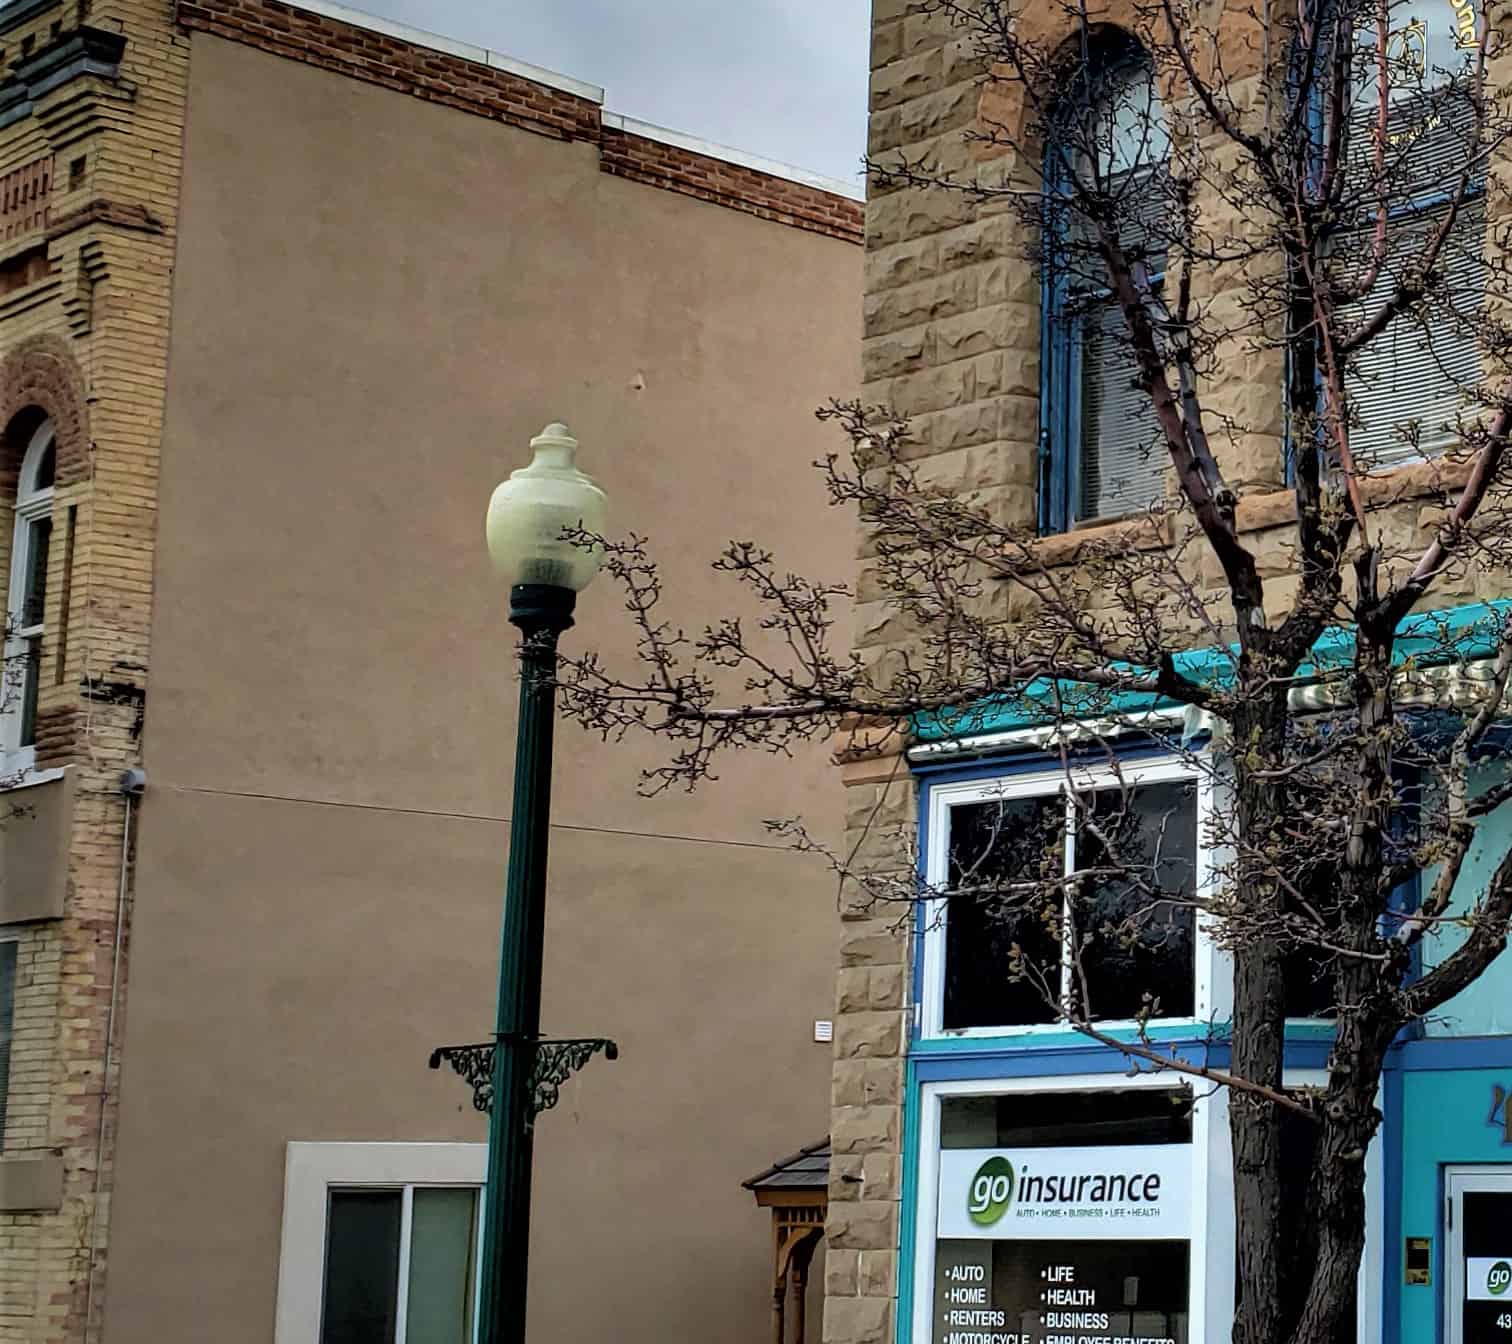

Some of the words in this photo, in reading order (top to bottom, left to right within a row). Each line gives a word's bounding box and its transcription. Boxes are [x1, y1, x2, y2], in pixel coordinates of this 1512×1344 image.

[969, 1174, 1010, 1212] go
[1017, 1164, 1161, 1203] insurance
[1016, 1208, 1035, 1217] AUTO
[1041, 1208, 1063, 1217] HOME
[1068, 1208, 1103, 1217] BUSINESS
[1110, 1208, 1125, 1217] LIFE
[1132, 1208, 1160, 1217] HEALTH
[951, 1265, 984, 1281] AUTO
[1047, 1266, 1074, 1283] LIFE
[1488, 1270, 1510, 1287] go
[951, 1287, 986, 1304] HOME
[1047, 1289, 1095, 1306] HEALTH
[950, 1311, 1005, 1327] RENTERS
[1047, 1313, 1109, 1330] BUSINESS
